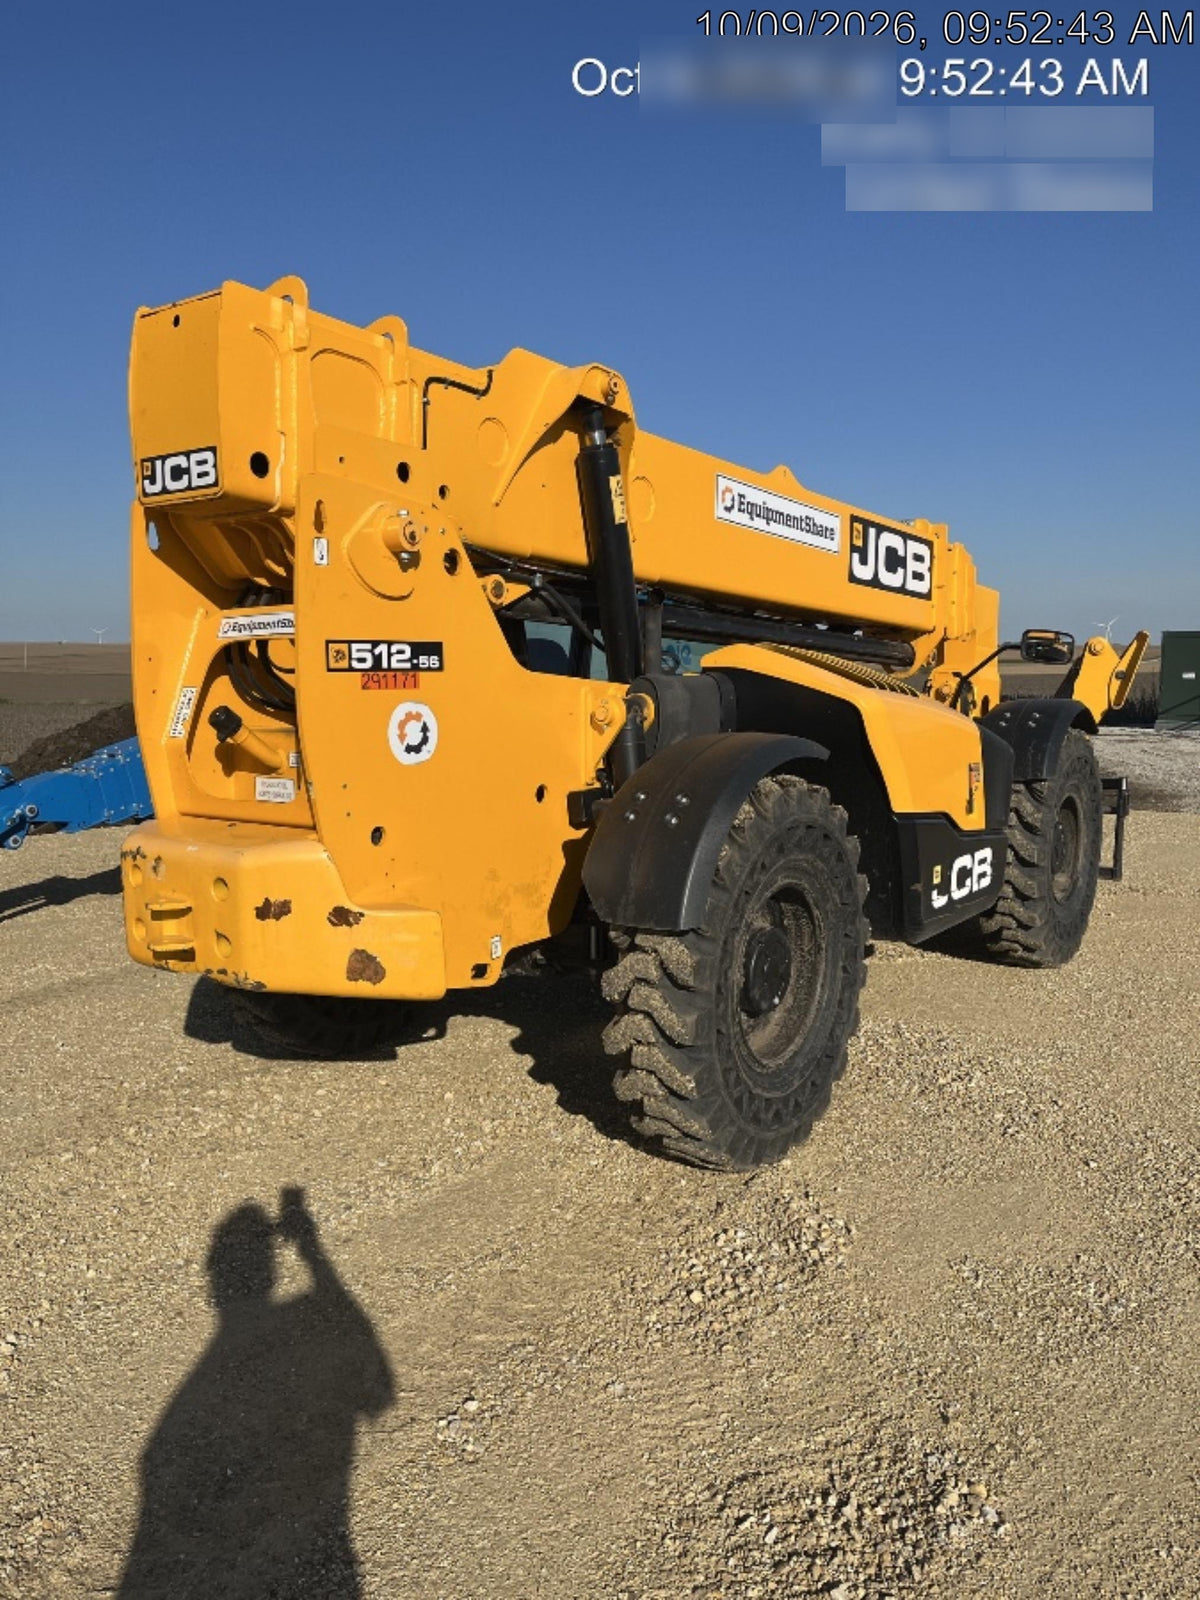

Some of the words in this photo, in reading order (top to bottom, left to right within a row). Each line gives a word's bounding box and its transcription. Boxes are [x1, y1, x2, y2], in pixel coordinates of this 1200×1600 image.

[143, 451, 216, 494] JCB
[737, 492, 835, 541] EquipmentShare
[851, 526, 931, 594] JCB
[361, 672, 417, 690] 291171
